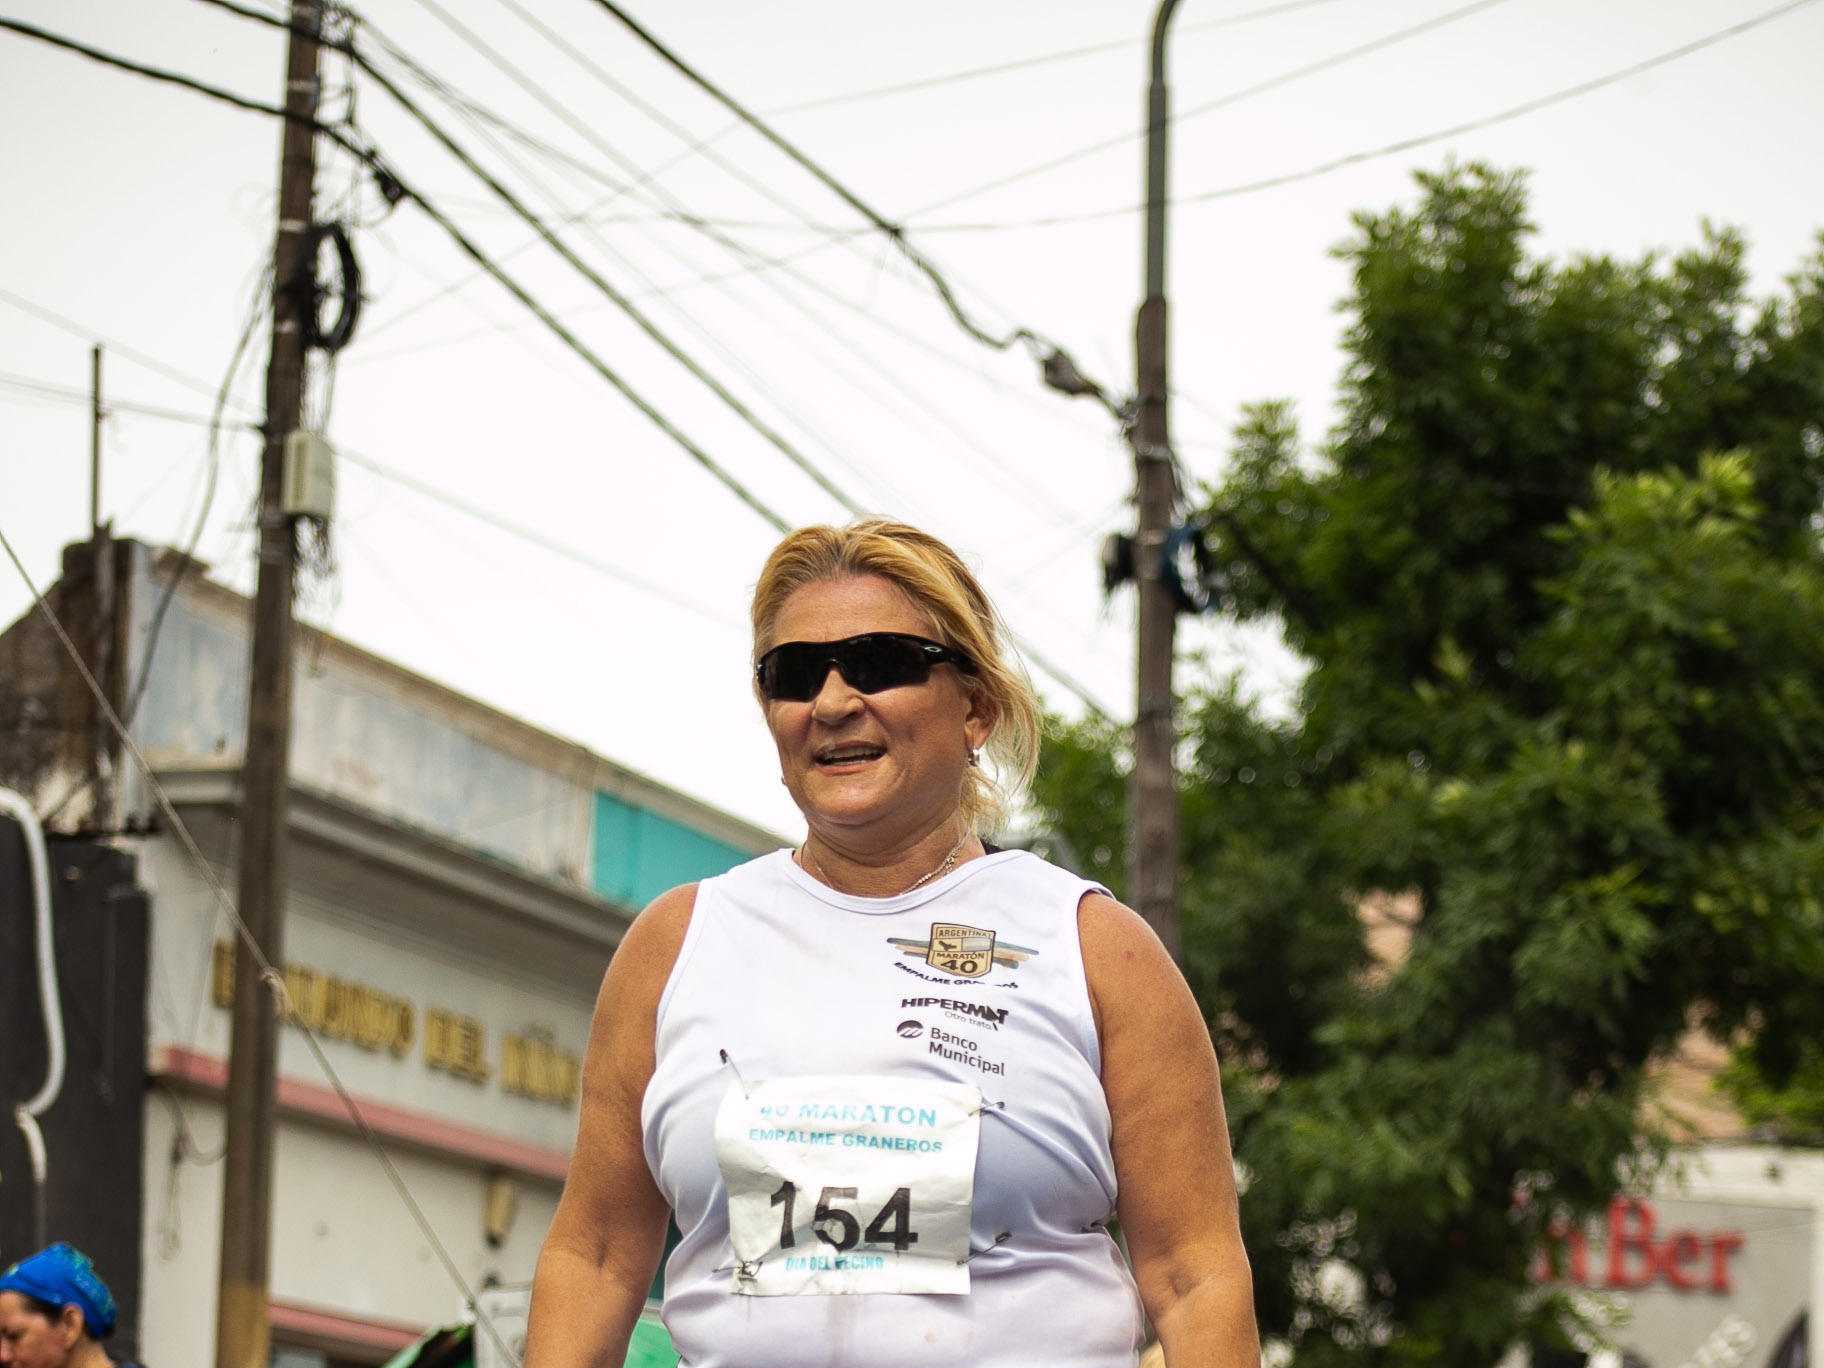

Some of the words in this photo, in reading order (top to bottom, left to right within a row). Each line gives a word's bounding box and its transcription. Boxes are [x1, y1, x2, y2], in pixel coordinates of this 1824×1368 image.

[938, 928, 987, 938] ARGENTINA
[936, 951, 985, 960] MARATÓN
[940, 959, 978, 974] 40
[893, 961, 951, 985] EMPALME
[944, 1010, 967, 1022] Otro
[930, 1027, 978, 1052] Banco
[928, 1041, 1006, 1077] Municipal
[799, 1103, 937, 1128] MARATON
[748, 1128, 836, 1146] EMPALME
[842, 1132, 943, 1153] GRANEROS
[770, 1180, 919, 1254] 154
[809, 1255, 831, 1271] DEL
